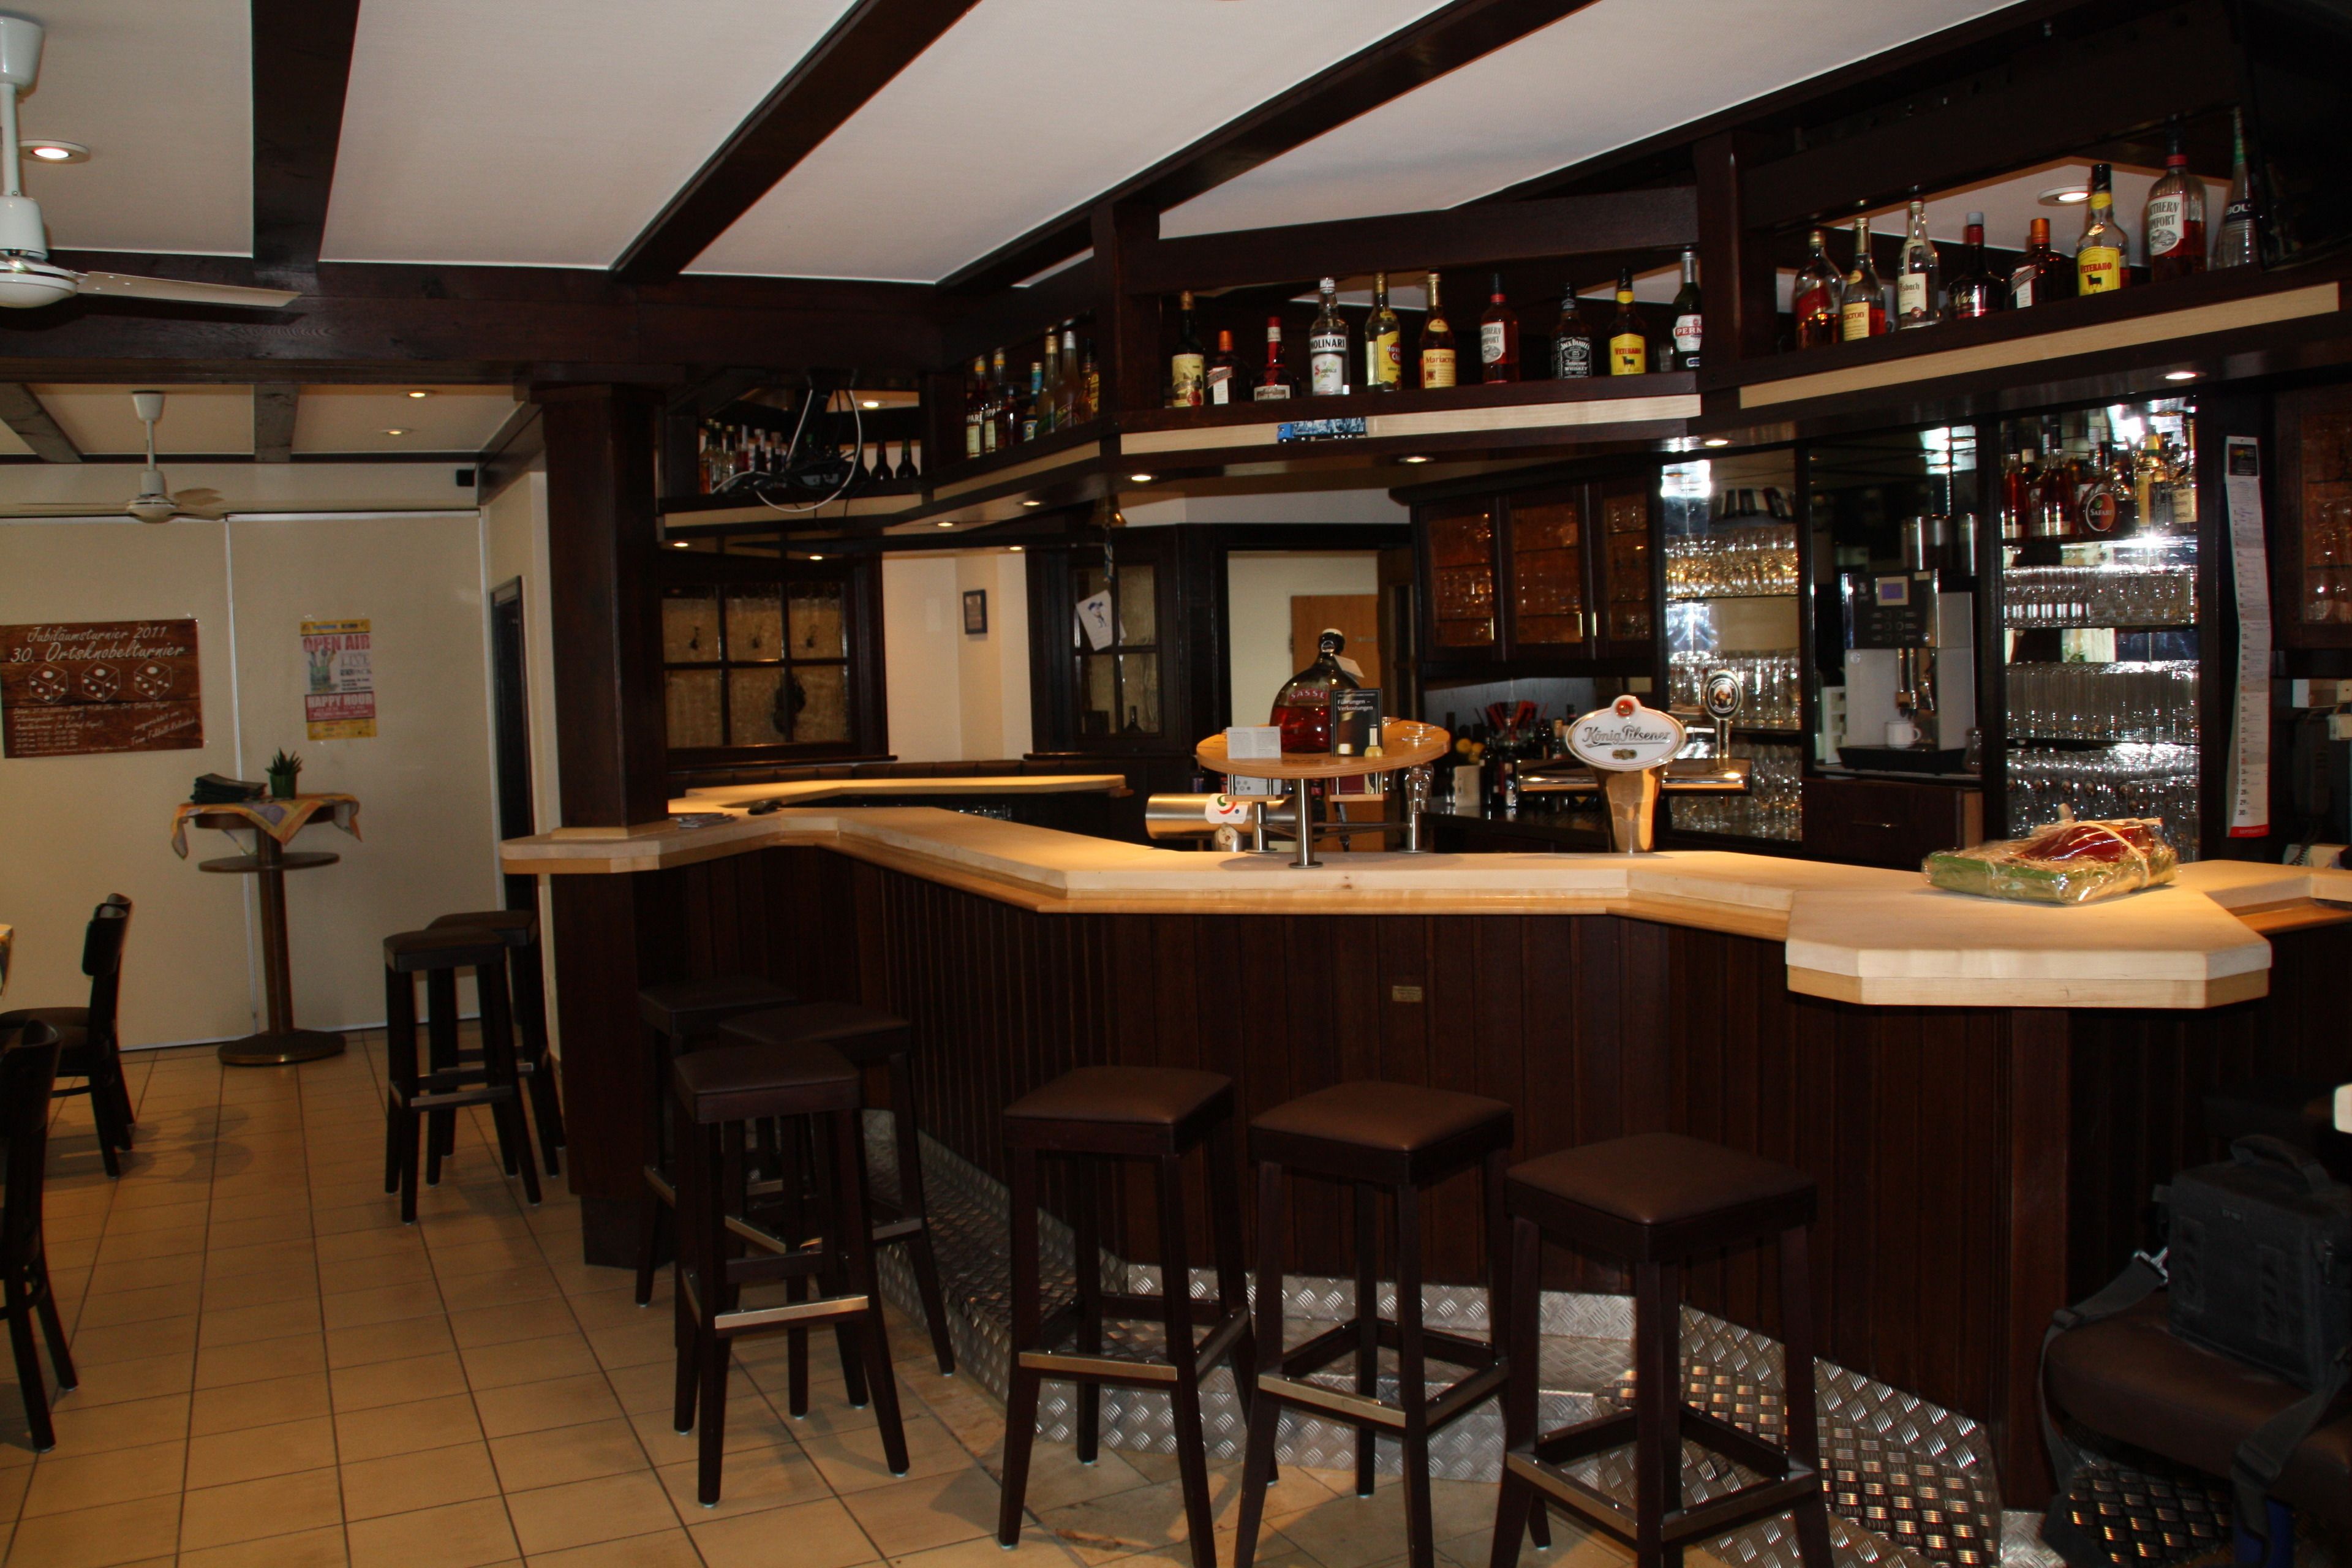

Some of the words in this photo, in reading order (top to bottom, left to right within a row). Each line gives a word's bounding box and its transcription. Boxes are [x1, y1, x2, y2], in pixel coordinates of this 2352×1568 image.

[133, 626, 167, 639] 2011
[345, 634, 371, 650] AIR
[308, 695, 342, 708] HAPPY
[343, 694, 374, 706] HOUR
[1291, 690, 1324, 699] SASSE
[1582, 726, 1622, 745] König
[1621, 725, 1672, 742] Pilsener
